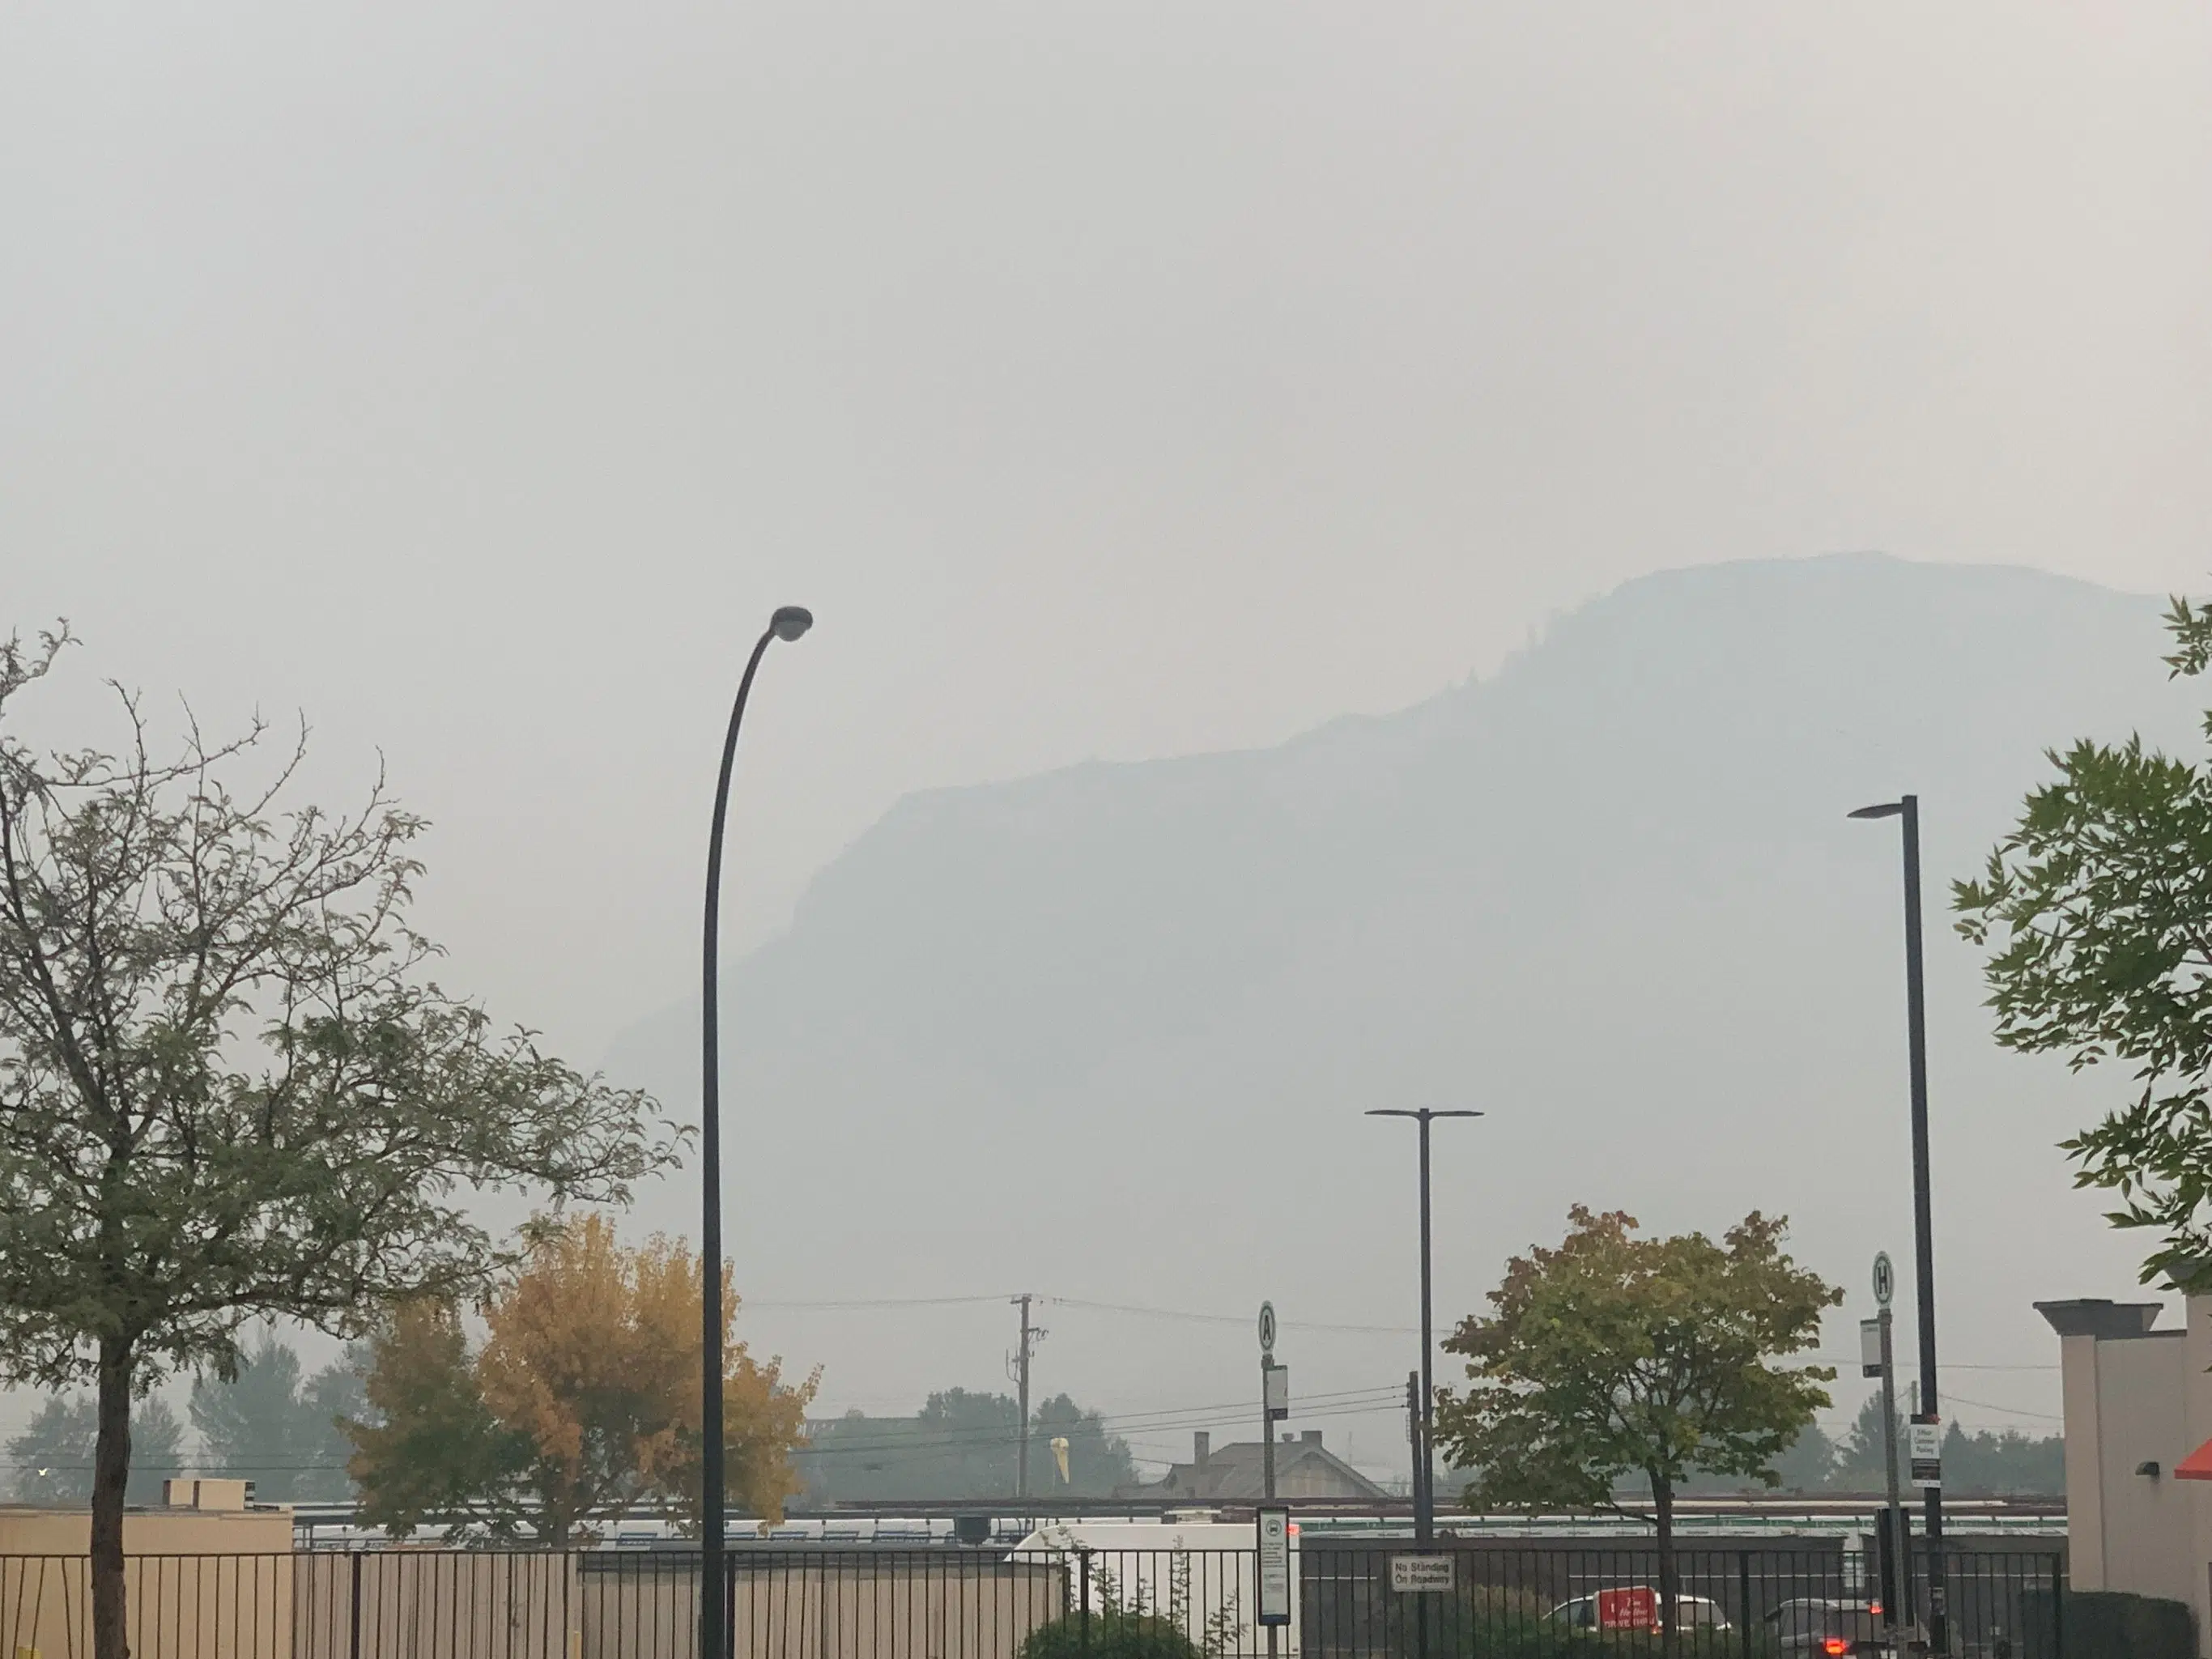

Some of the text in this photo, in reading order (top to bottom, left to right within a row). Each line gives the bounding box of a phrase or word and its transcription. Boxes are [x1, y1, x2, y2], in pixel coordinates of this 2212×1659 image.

[1877, 1266, 1888, 1294] H
[1263, 1314, 1271, 1341] A
[1395, 1562, 1449, 1573] No Standing
[1395, 1573, 1449, 1585] On Roadway
